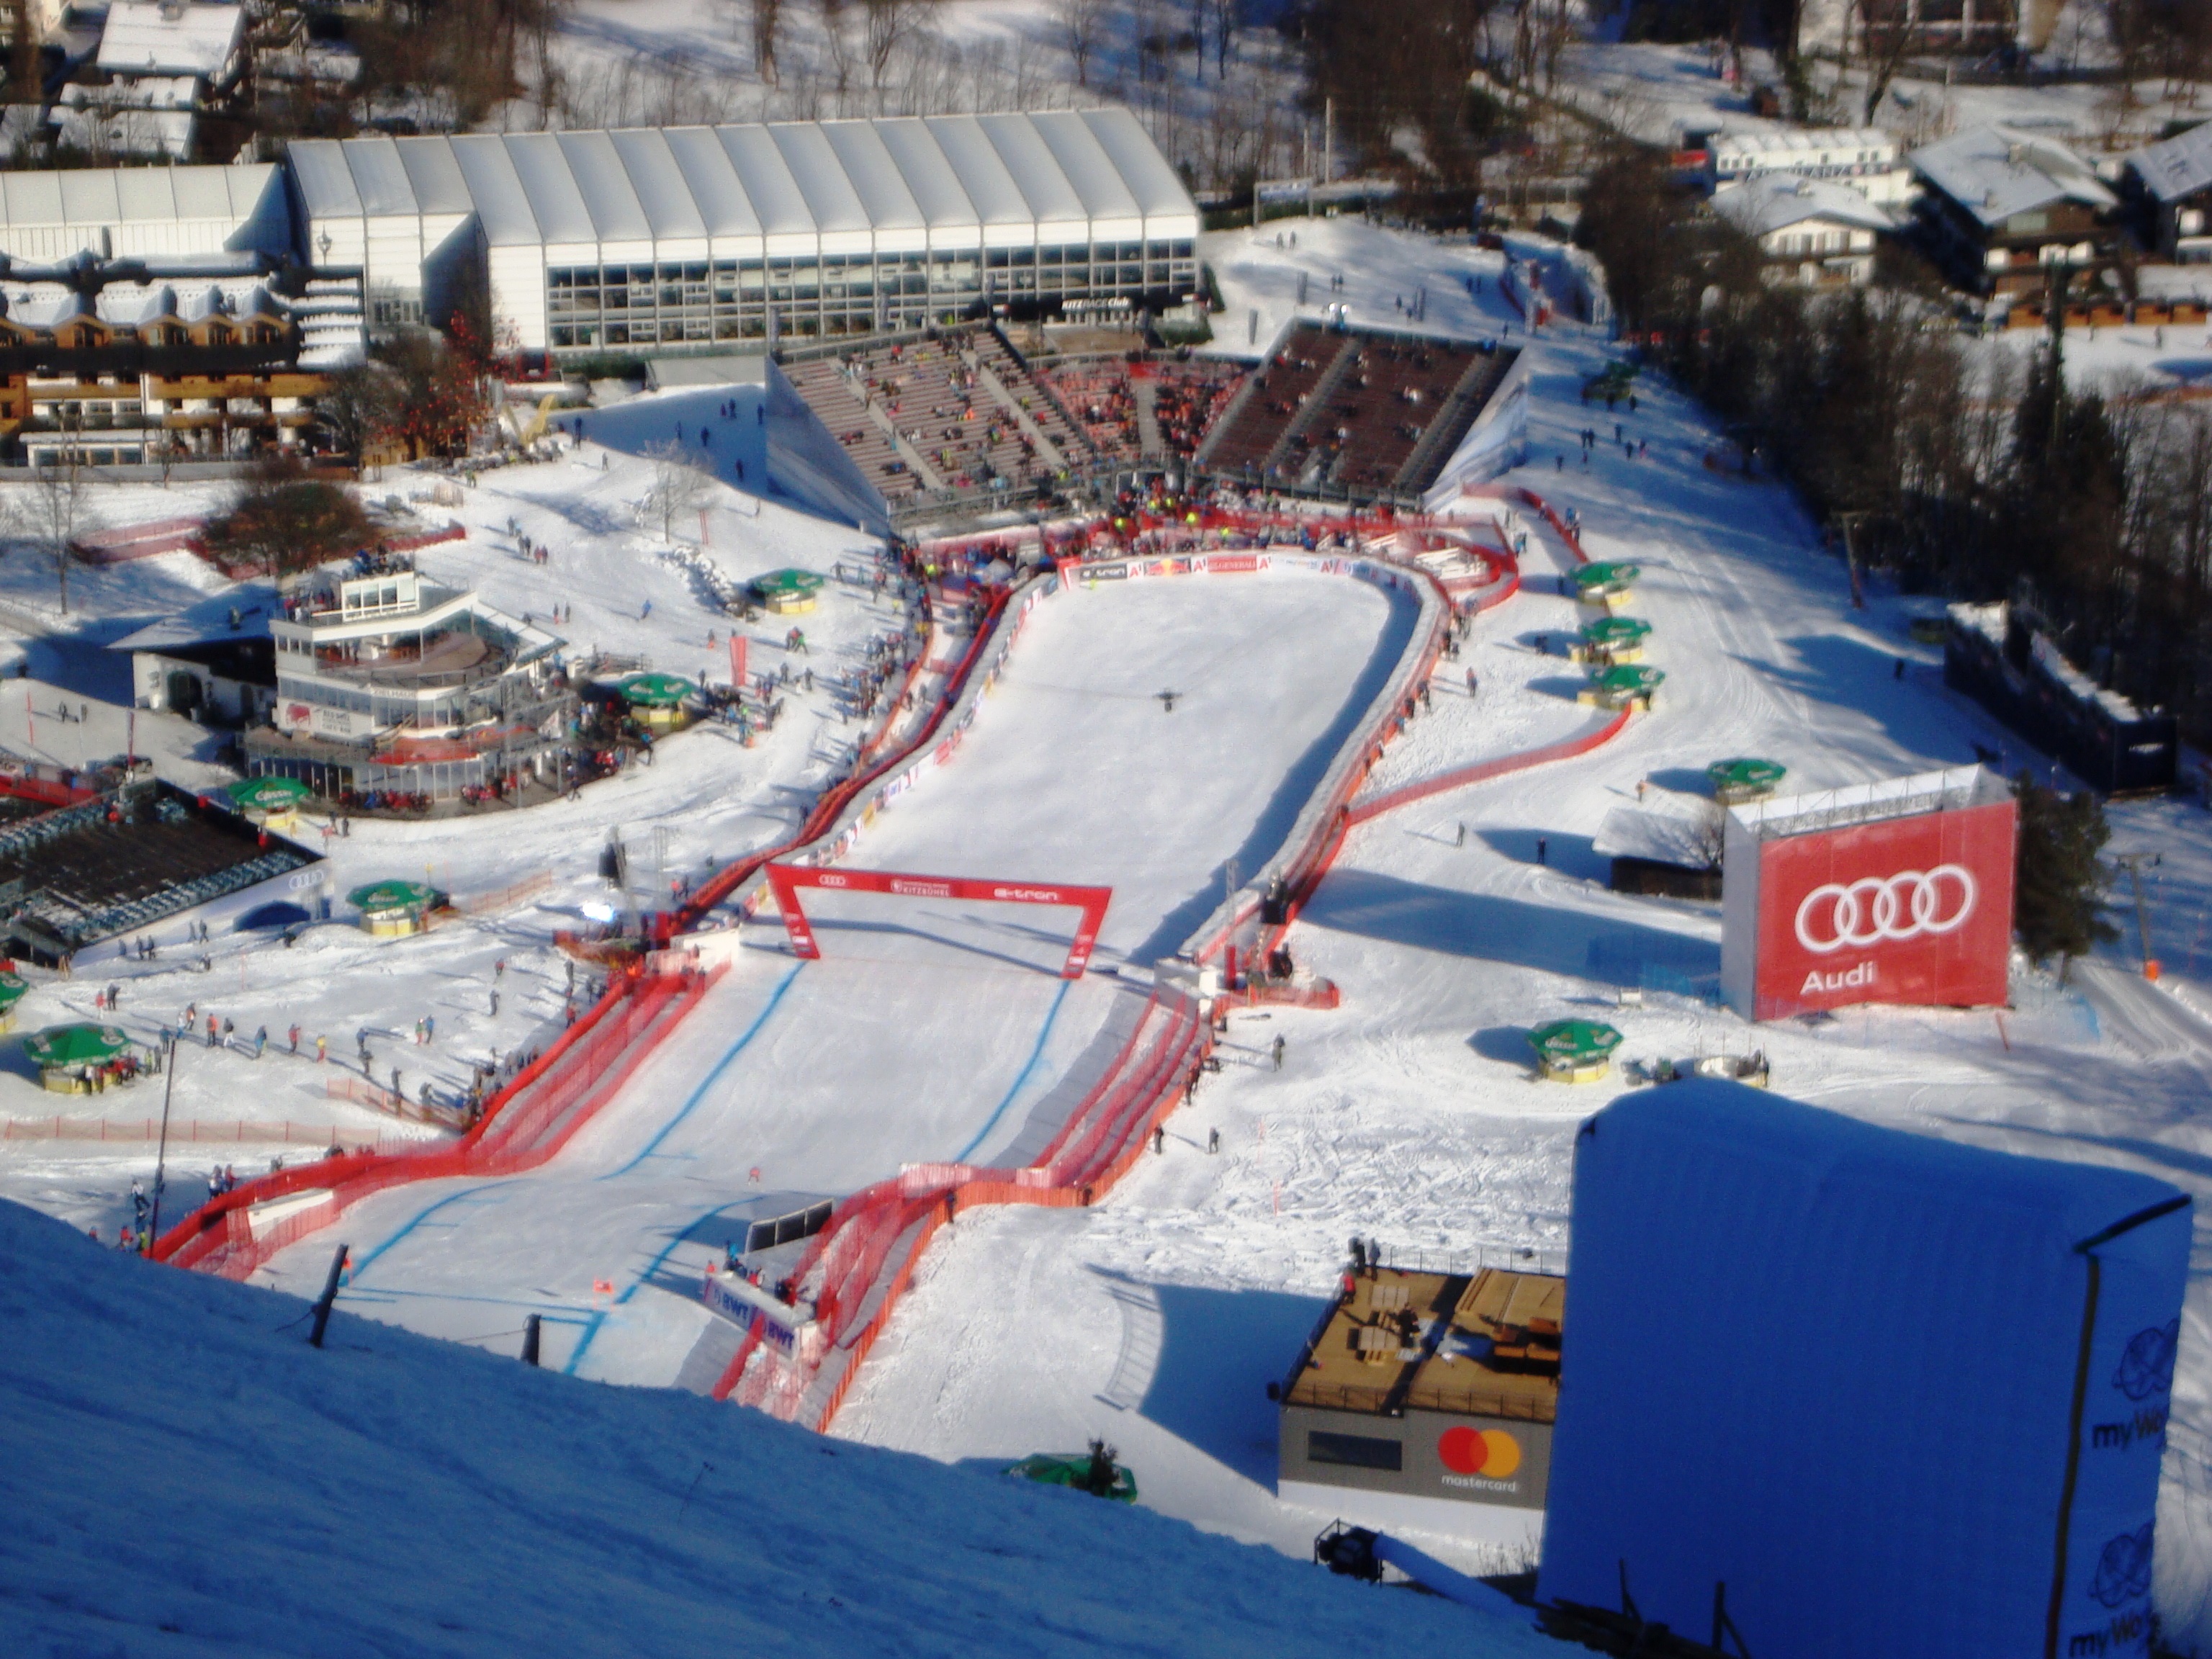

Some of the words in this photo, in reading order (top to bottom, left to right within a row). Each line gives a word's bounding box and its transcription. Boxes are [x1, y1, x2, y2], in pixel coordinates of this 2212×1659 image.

[1082, 567, 1126, 578] etron
[1800, 961, 1876, 994] Audi
[722, 1292, 749, 1321] BWT
[768, 1320, 795, 1350] BWT
[1441, 1473, 1516, 1493] mastercard
